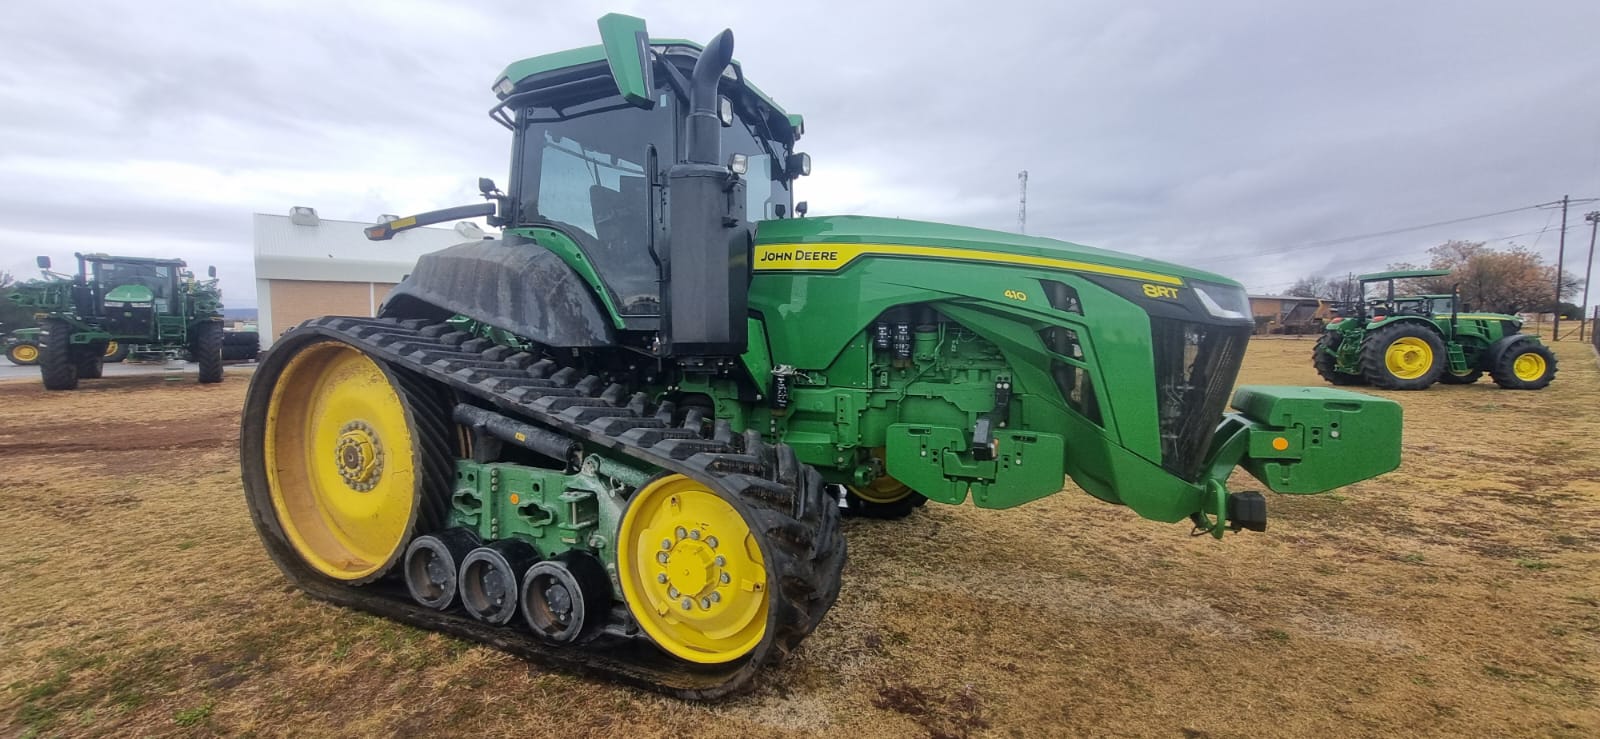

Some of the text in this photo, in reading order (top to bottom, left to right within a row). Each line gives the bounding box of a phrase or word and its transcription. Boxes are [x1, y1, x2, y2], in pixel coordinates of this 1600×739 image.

[760, 250, 838, 261] JOHN DEERE
[1004, 289, 1027, 301] 410
[1142, 283, 1178, 299] 8RT
